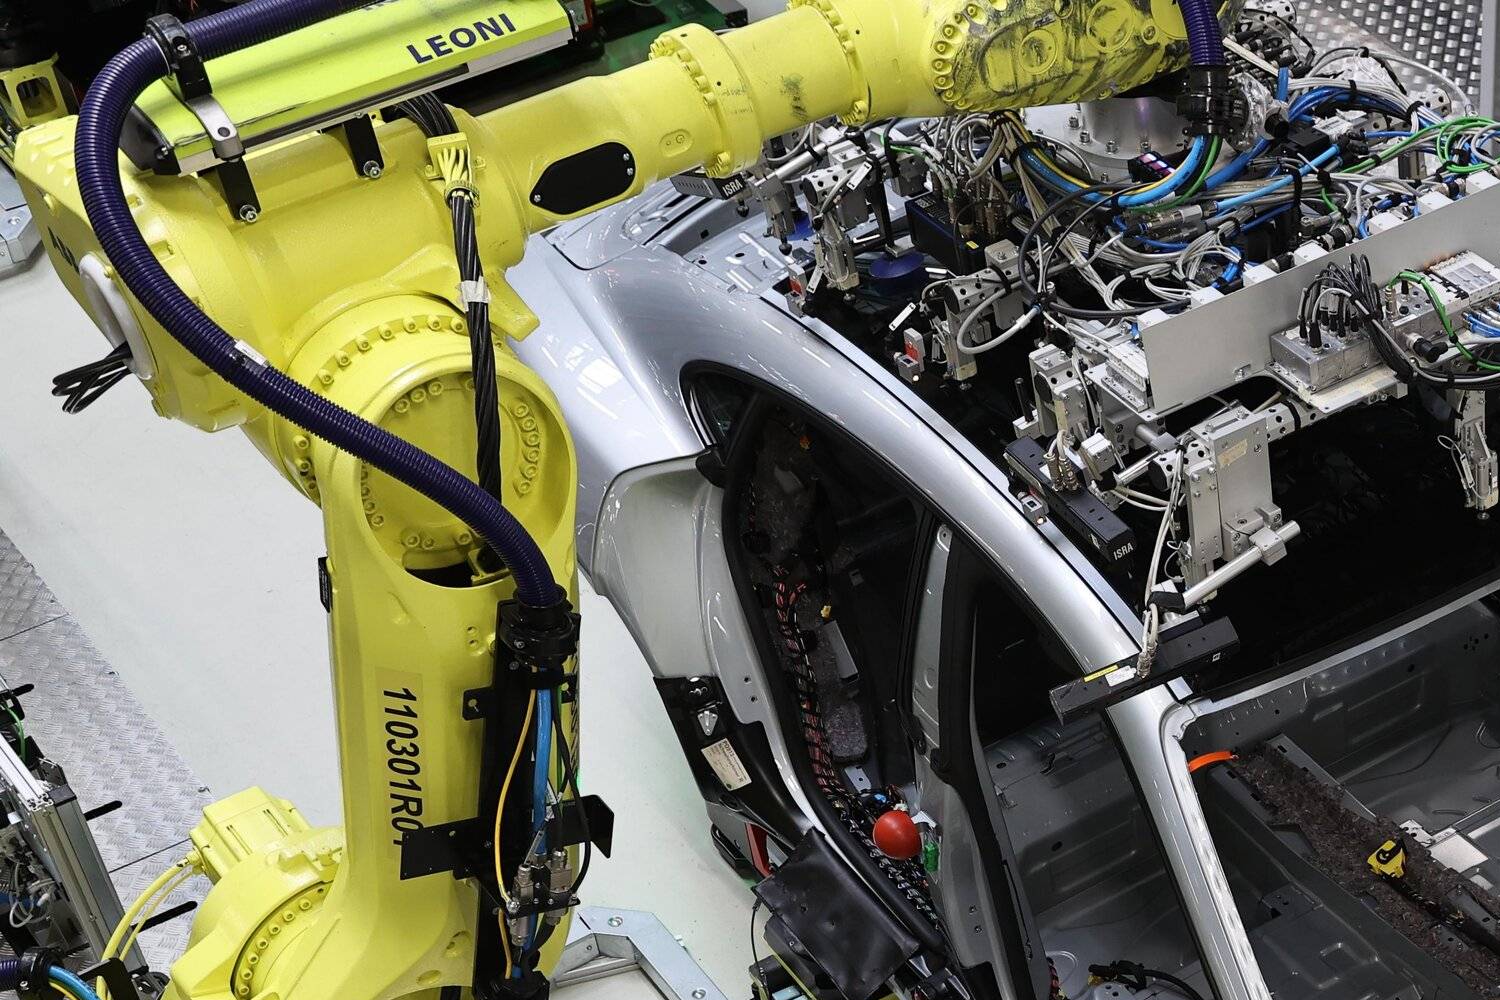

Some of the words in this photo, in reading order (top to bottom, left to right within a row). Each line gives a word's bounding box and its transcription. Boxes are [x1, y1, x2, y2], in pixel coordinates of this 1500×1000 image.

[406, 13, 516, 64] LEONI
[722, 178, 743, 197] ISRA
[1113, 542, 1134, 561] ISRA
[383, 687, 424, 846] 110301R0
